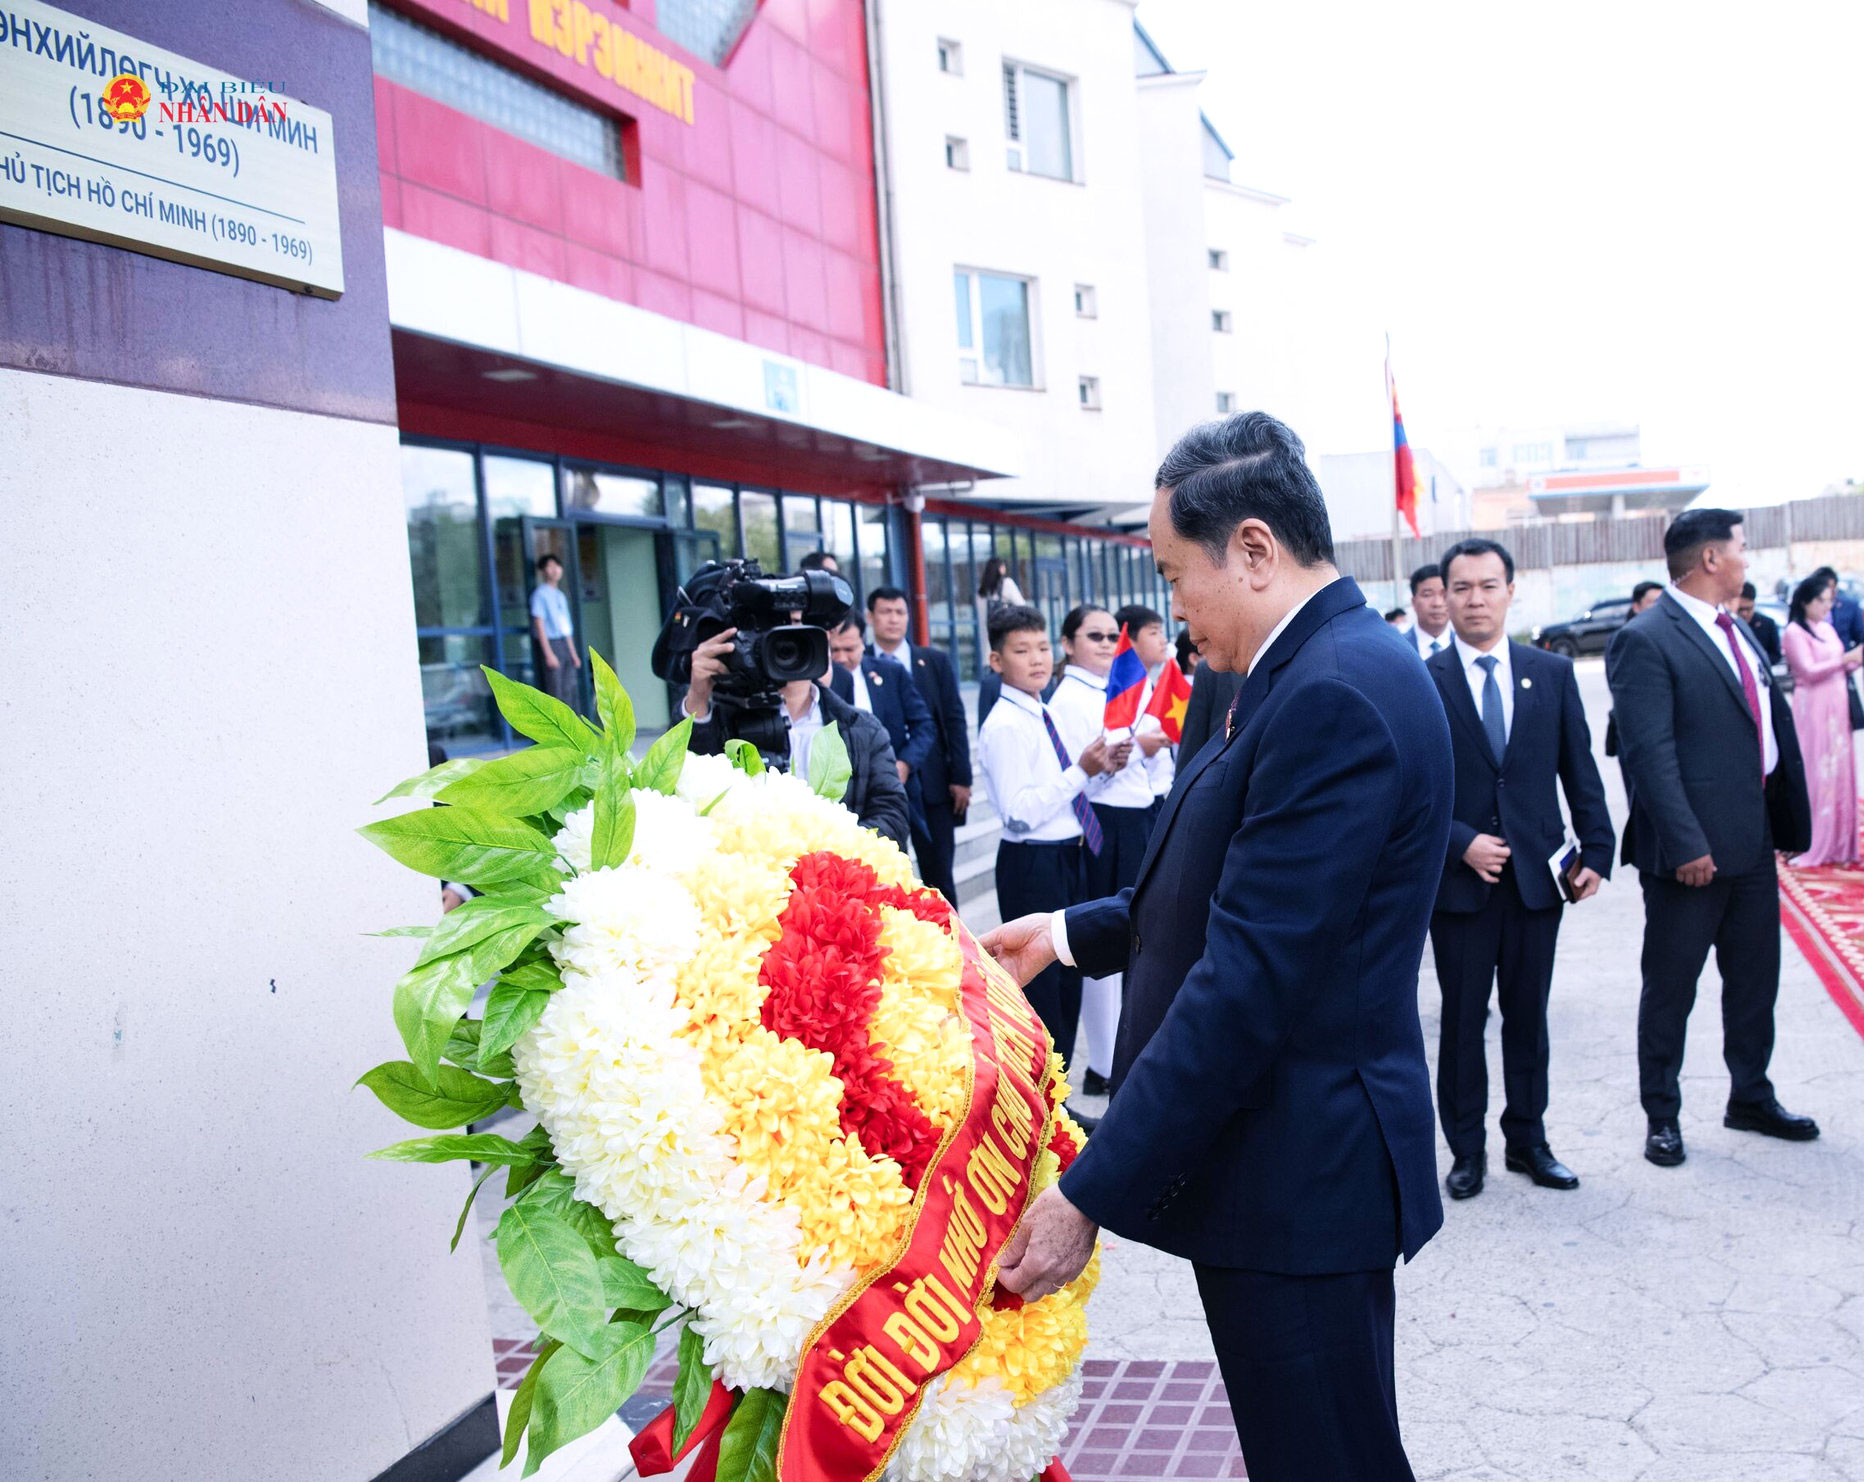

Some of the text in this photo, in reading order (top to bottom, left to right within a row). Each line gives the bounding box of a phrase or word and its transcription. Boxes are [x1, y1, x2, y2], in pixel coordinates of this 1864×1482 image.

[173, 123, 239, 178] 1969)
[267, 108, 318, 154] МИН
[30, 163, 82, 199] TỊCH
[87, 176, 116, 208] HỒ
[121, 191, 154, 219] CHÍ
[159, 199, 207, 234] MINH
[212, 213, 256, 246] (1890
[272, 232, 313, 266] 1969)
[818, 1343, 919, 1444] ĐỜI
[882, 1273, 973, 1374] ĐỜI
[938, 1174, 988, 1302] NHỚ
[966, 1131, 1022, 1216] ƠN
